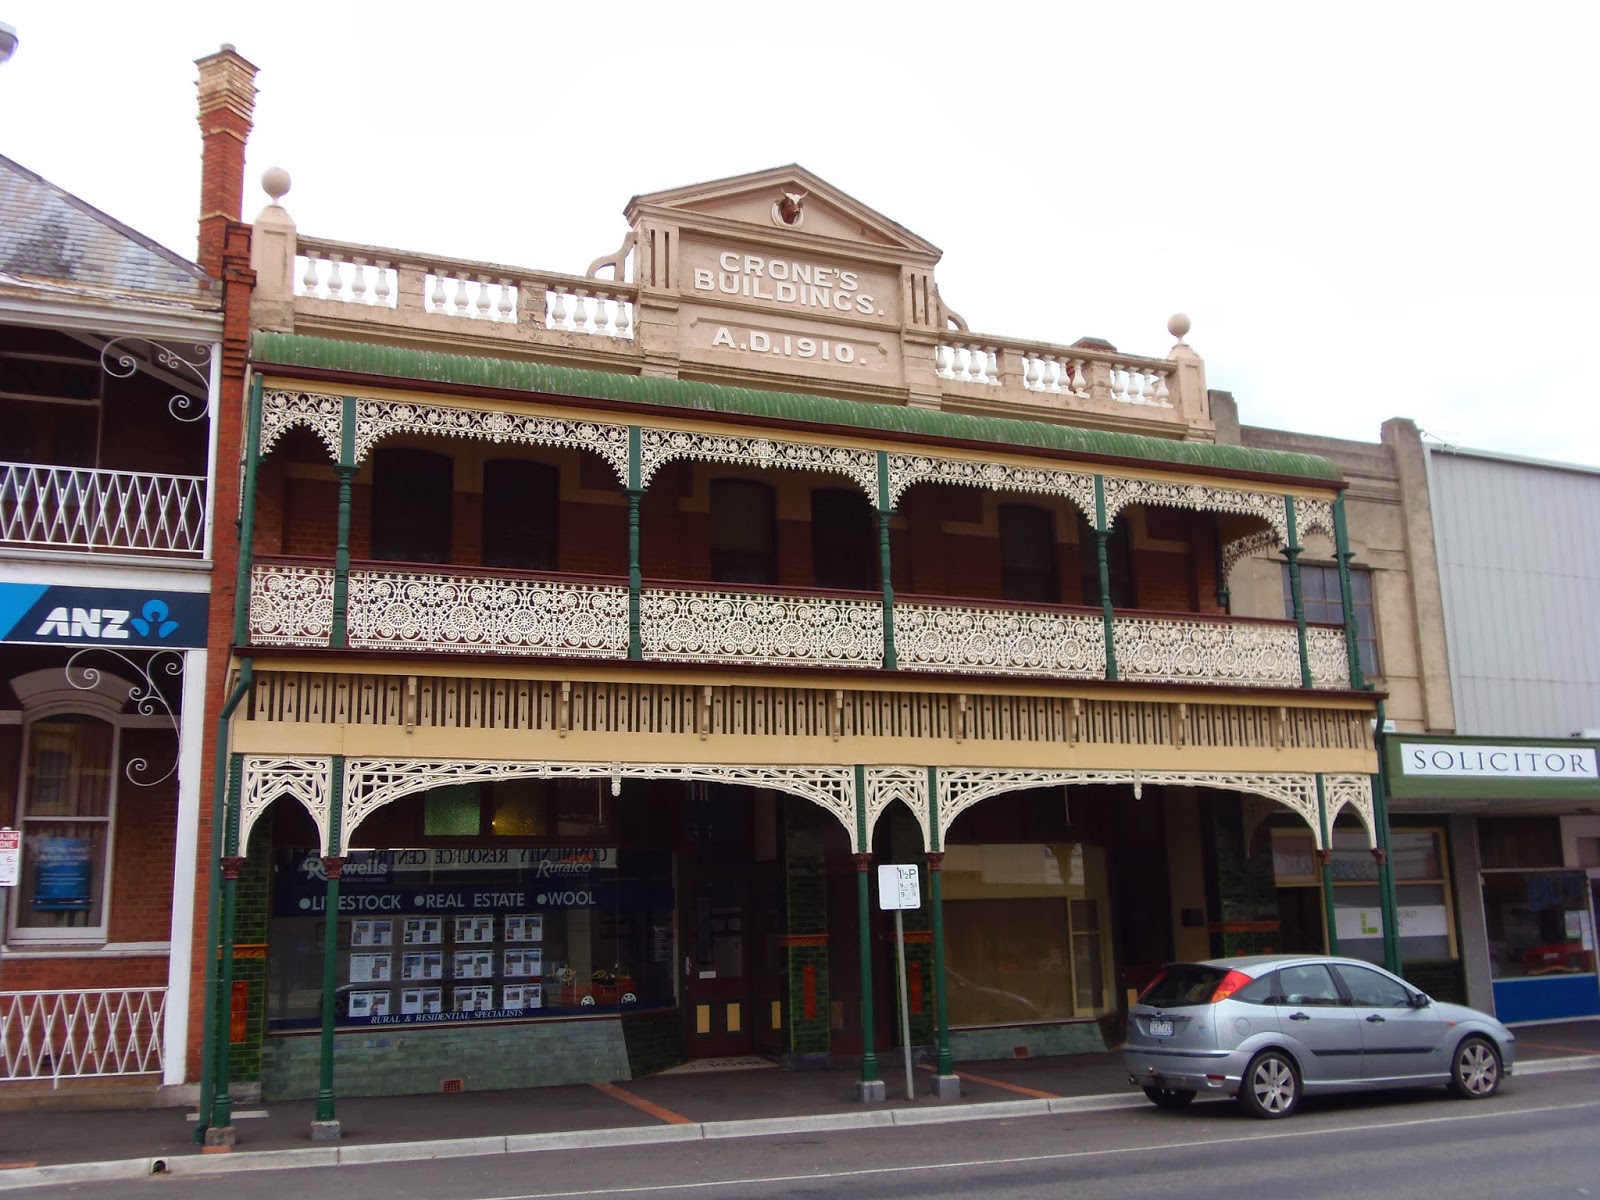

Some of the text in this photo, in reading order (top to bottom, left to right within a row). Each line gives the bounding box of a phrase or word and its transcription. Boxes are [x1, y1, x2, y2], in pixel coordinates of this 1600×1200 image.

[719, 251, 859, 291] CRONE'S
[694, 267, 885, 317] BUILDINGS.
[35, 606, 131, 639] ANZ
[1413, 749, 1589, 773] SOLICITOR
[535, 859, 592, 878] Ruralco
[312, 891, 597, 911] LIESTOCK REAL ESTATE WOOL
[370, 1009, 524, 1024] RURAL & RESIDENTIAL SPECIALISTS
